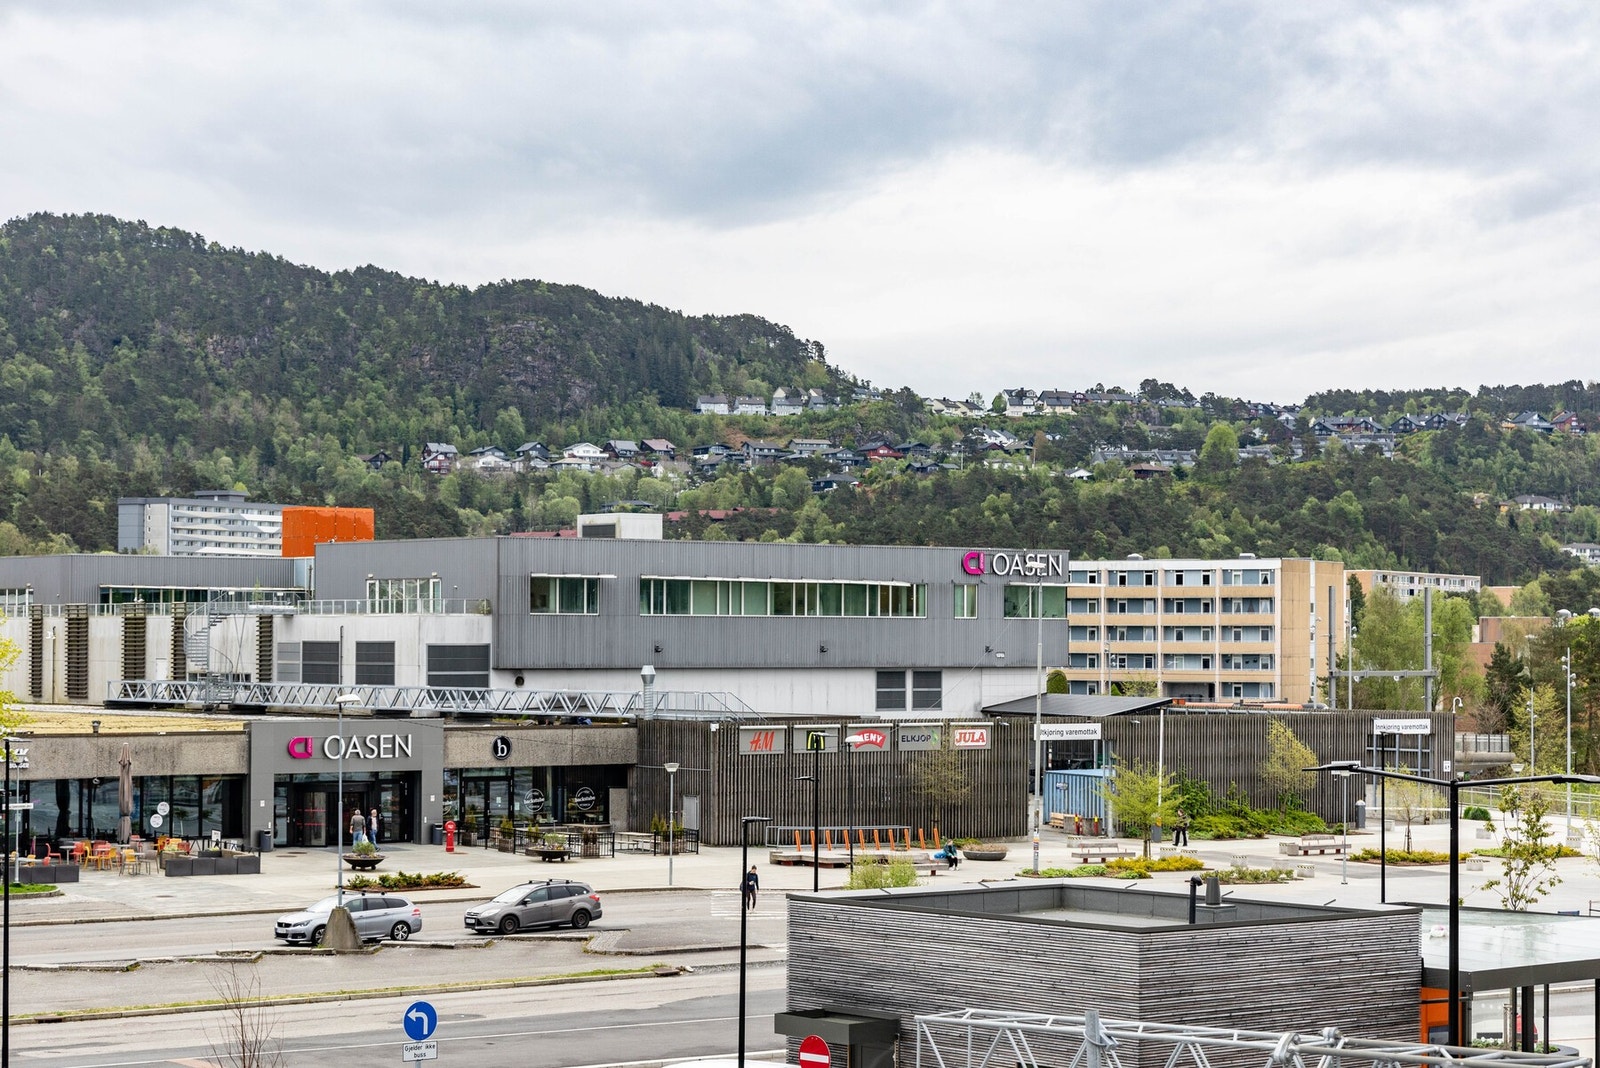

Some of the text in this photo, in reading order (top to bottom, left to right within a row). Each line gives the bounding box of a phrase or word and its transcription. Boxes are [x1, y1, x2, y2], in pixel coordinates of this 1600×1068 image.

[993, 553, 1062, 576] OASEN
[955, 731, 986, 743] JULA
[1066, 728, 1097, 736] varemottak
[324, 734, 412, 760] OASEN
[750, 731, 775, 752] H&M
[405, 1044, 422, 1052] Gjelder
